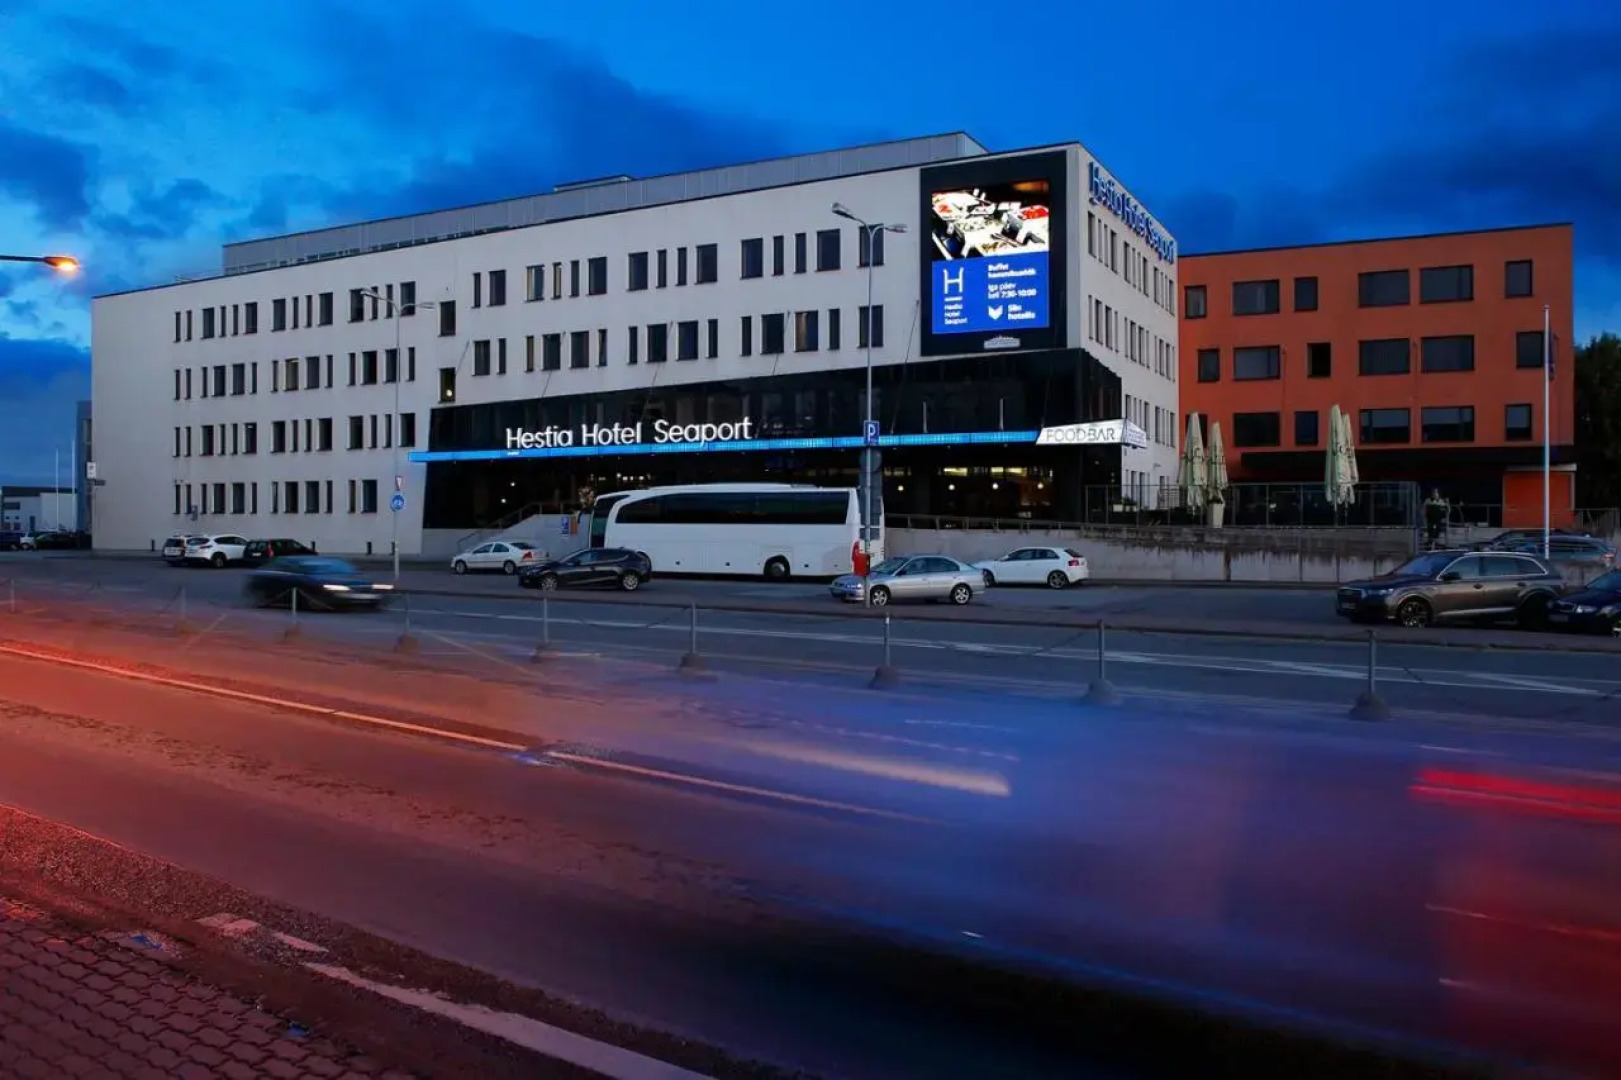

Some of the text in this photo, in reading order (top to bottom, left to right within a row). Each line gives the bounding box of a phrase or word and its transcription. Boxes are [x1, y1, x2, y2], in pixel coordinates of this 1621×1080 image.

[943, 266, 964, 294] H
[506, 416, 752, 449] Hestia Hotel Seaport
